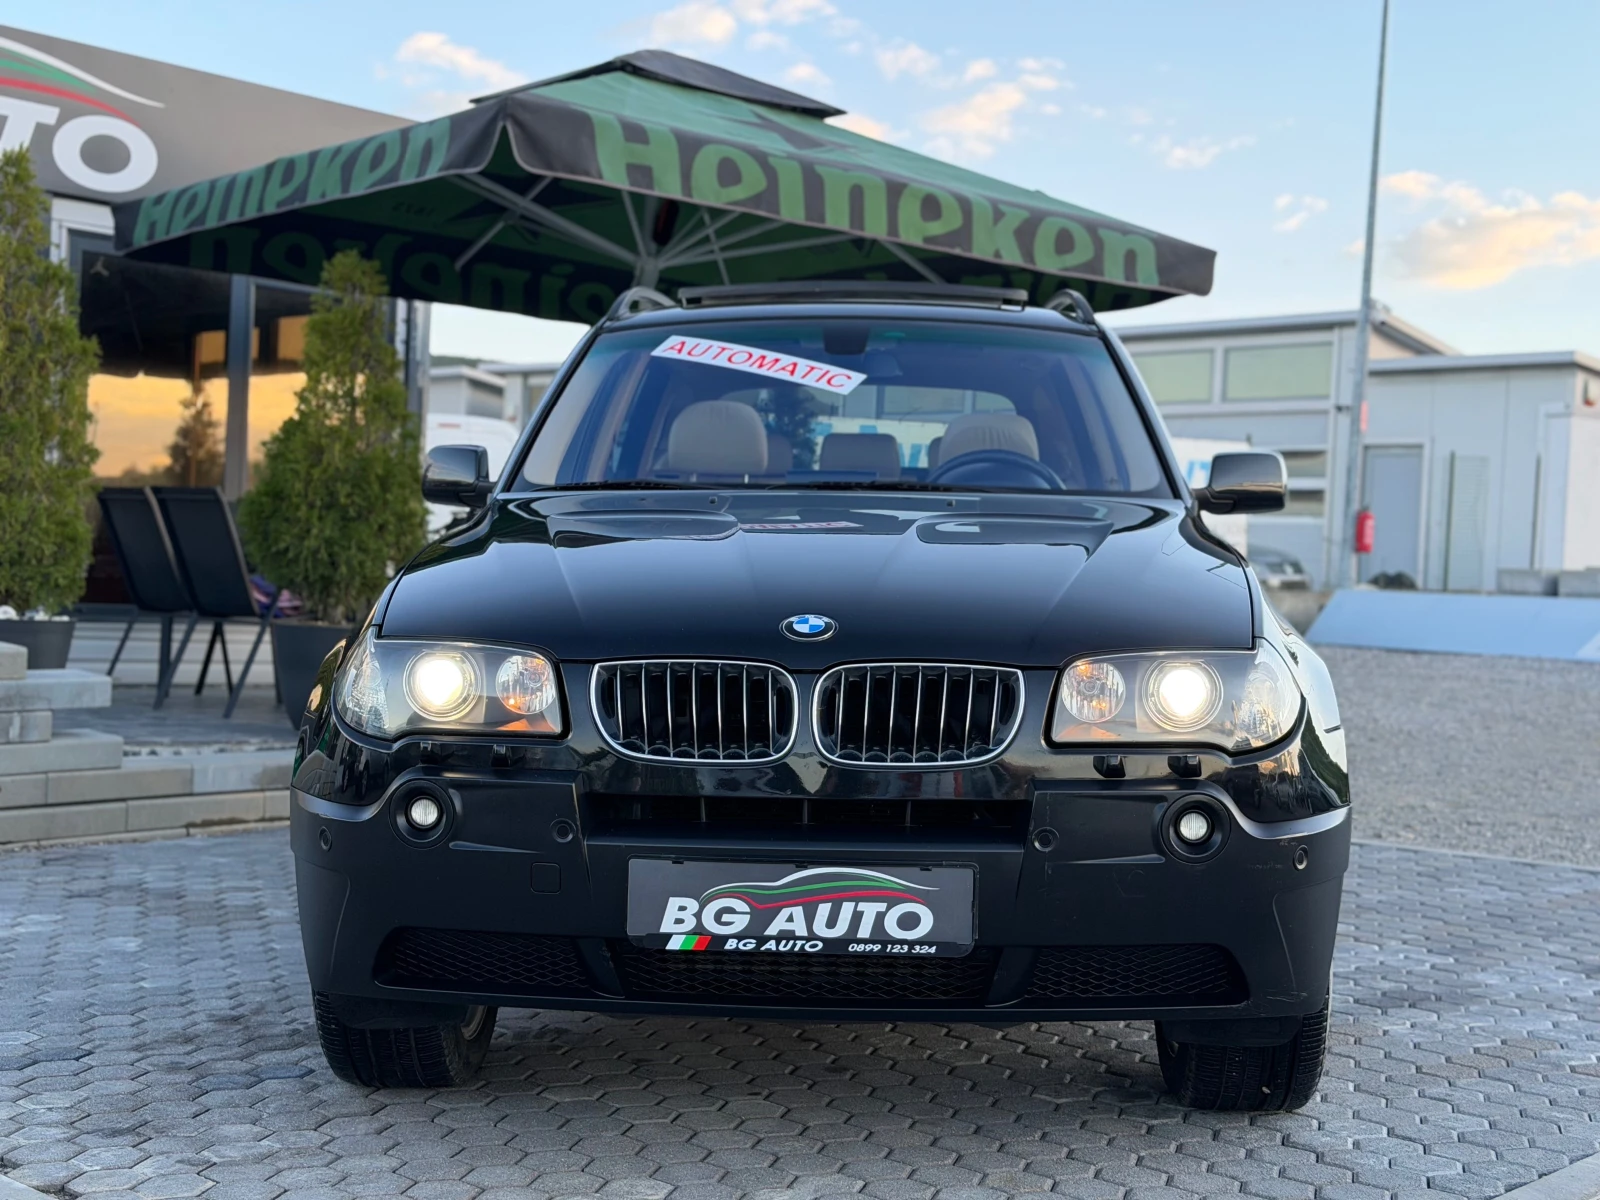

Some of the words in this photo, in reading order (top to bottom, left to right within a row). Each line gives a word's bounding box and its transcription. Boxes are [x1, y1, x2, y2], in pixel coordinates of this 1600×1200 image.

[133, 117, 450, 246] Heineken
[592, 112, 1161, 286] Heineken
[664, 340, 853, 388] AUTOMATIC
[660, 897, 751, 934] BG
[764, 901, 934, 940] AUTO
[724, 938, 757, 951] BG
[760, 940, 824, 952] AUTO
[848, 943, 881, 952] 0899
[886, 944, 910, 953] 123
[913, 945, 937, 954] 324
